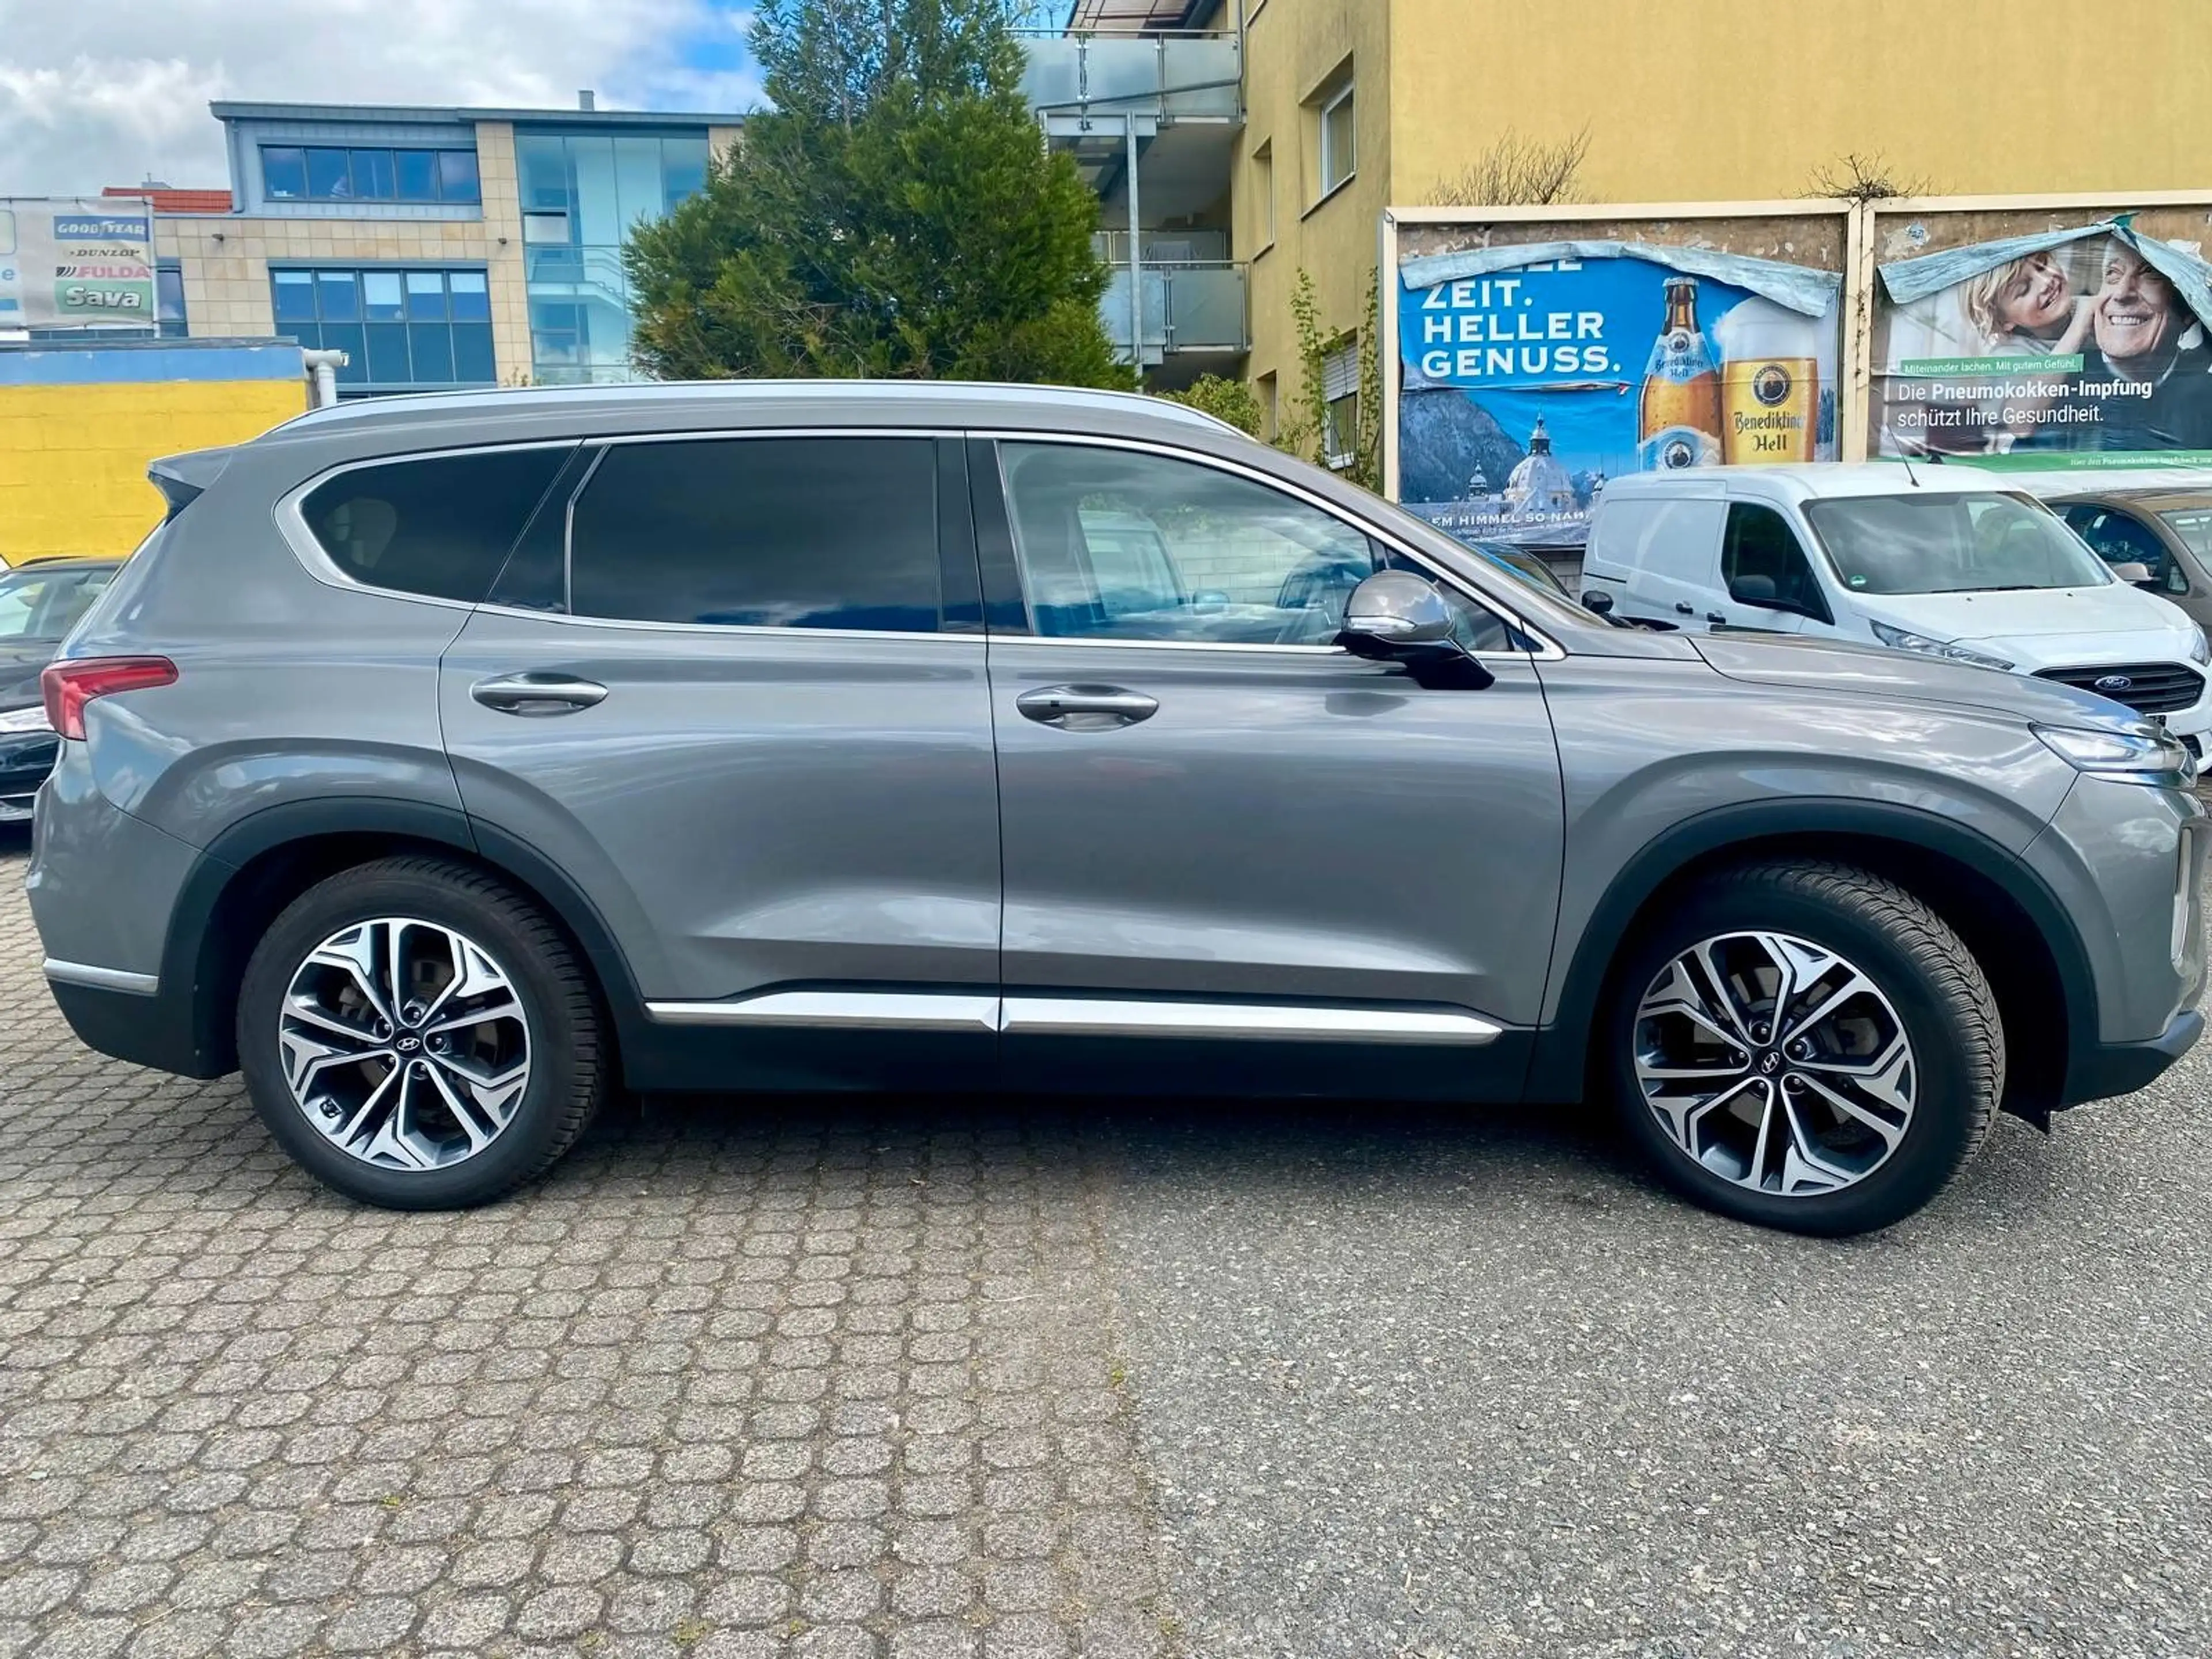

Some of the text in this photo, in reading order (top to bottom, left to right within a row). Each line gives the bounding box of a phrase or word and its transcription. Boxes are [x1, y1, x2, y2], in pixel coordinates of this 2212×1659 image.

[58, 222, 145, 236] GOODYEAR
[76, 248, 138, 257] DUNLOP
[76, 266, 151, 278] FULDA
[66, 286, 142, 308] Sava
[1421, 279, 1532, 309] ZEIT.
[1424, 311, 1604, 343] HELLER
[1421, 346, 1621, 378] GENUSS.
[1904, 361, 1959, 374] Miteinander
[1961, 361, 1993, 372] lachen.
[1996, 358, 2011, 370] Mit
[2013, 360, 2042, 372] gutem
[1899, 378, 2153, 400] Die Pneumokokken-Impfung
[1733, 411, 1806, 435] Benediktin
[1897, 404, 2104, 427] schützt Ihre Gesundheit.
[1752, 434, 1787, 452] Hell
[1431, 516, 1453, 527] EM
[1459, 514, 1521, 525] HIMMEL
[1525, 513, 1546, 522] SO
